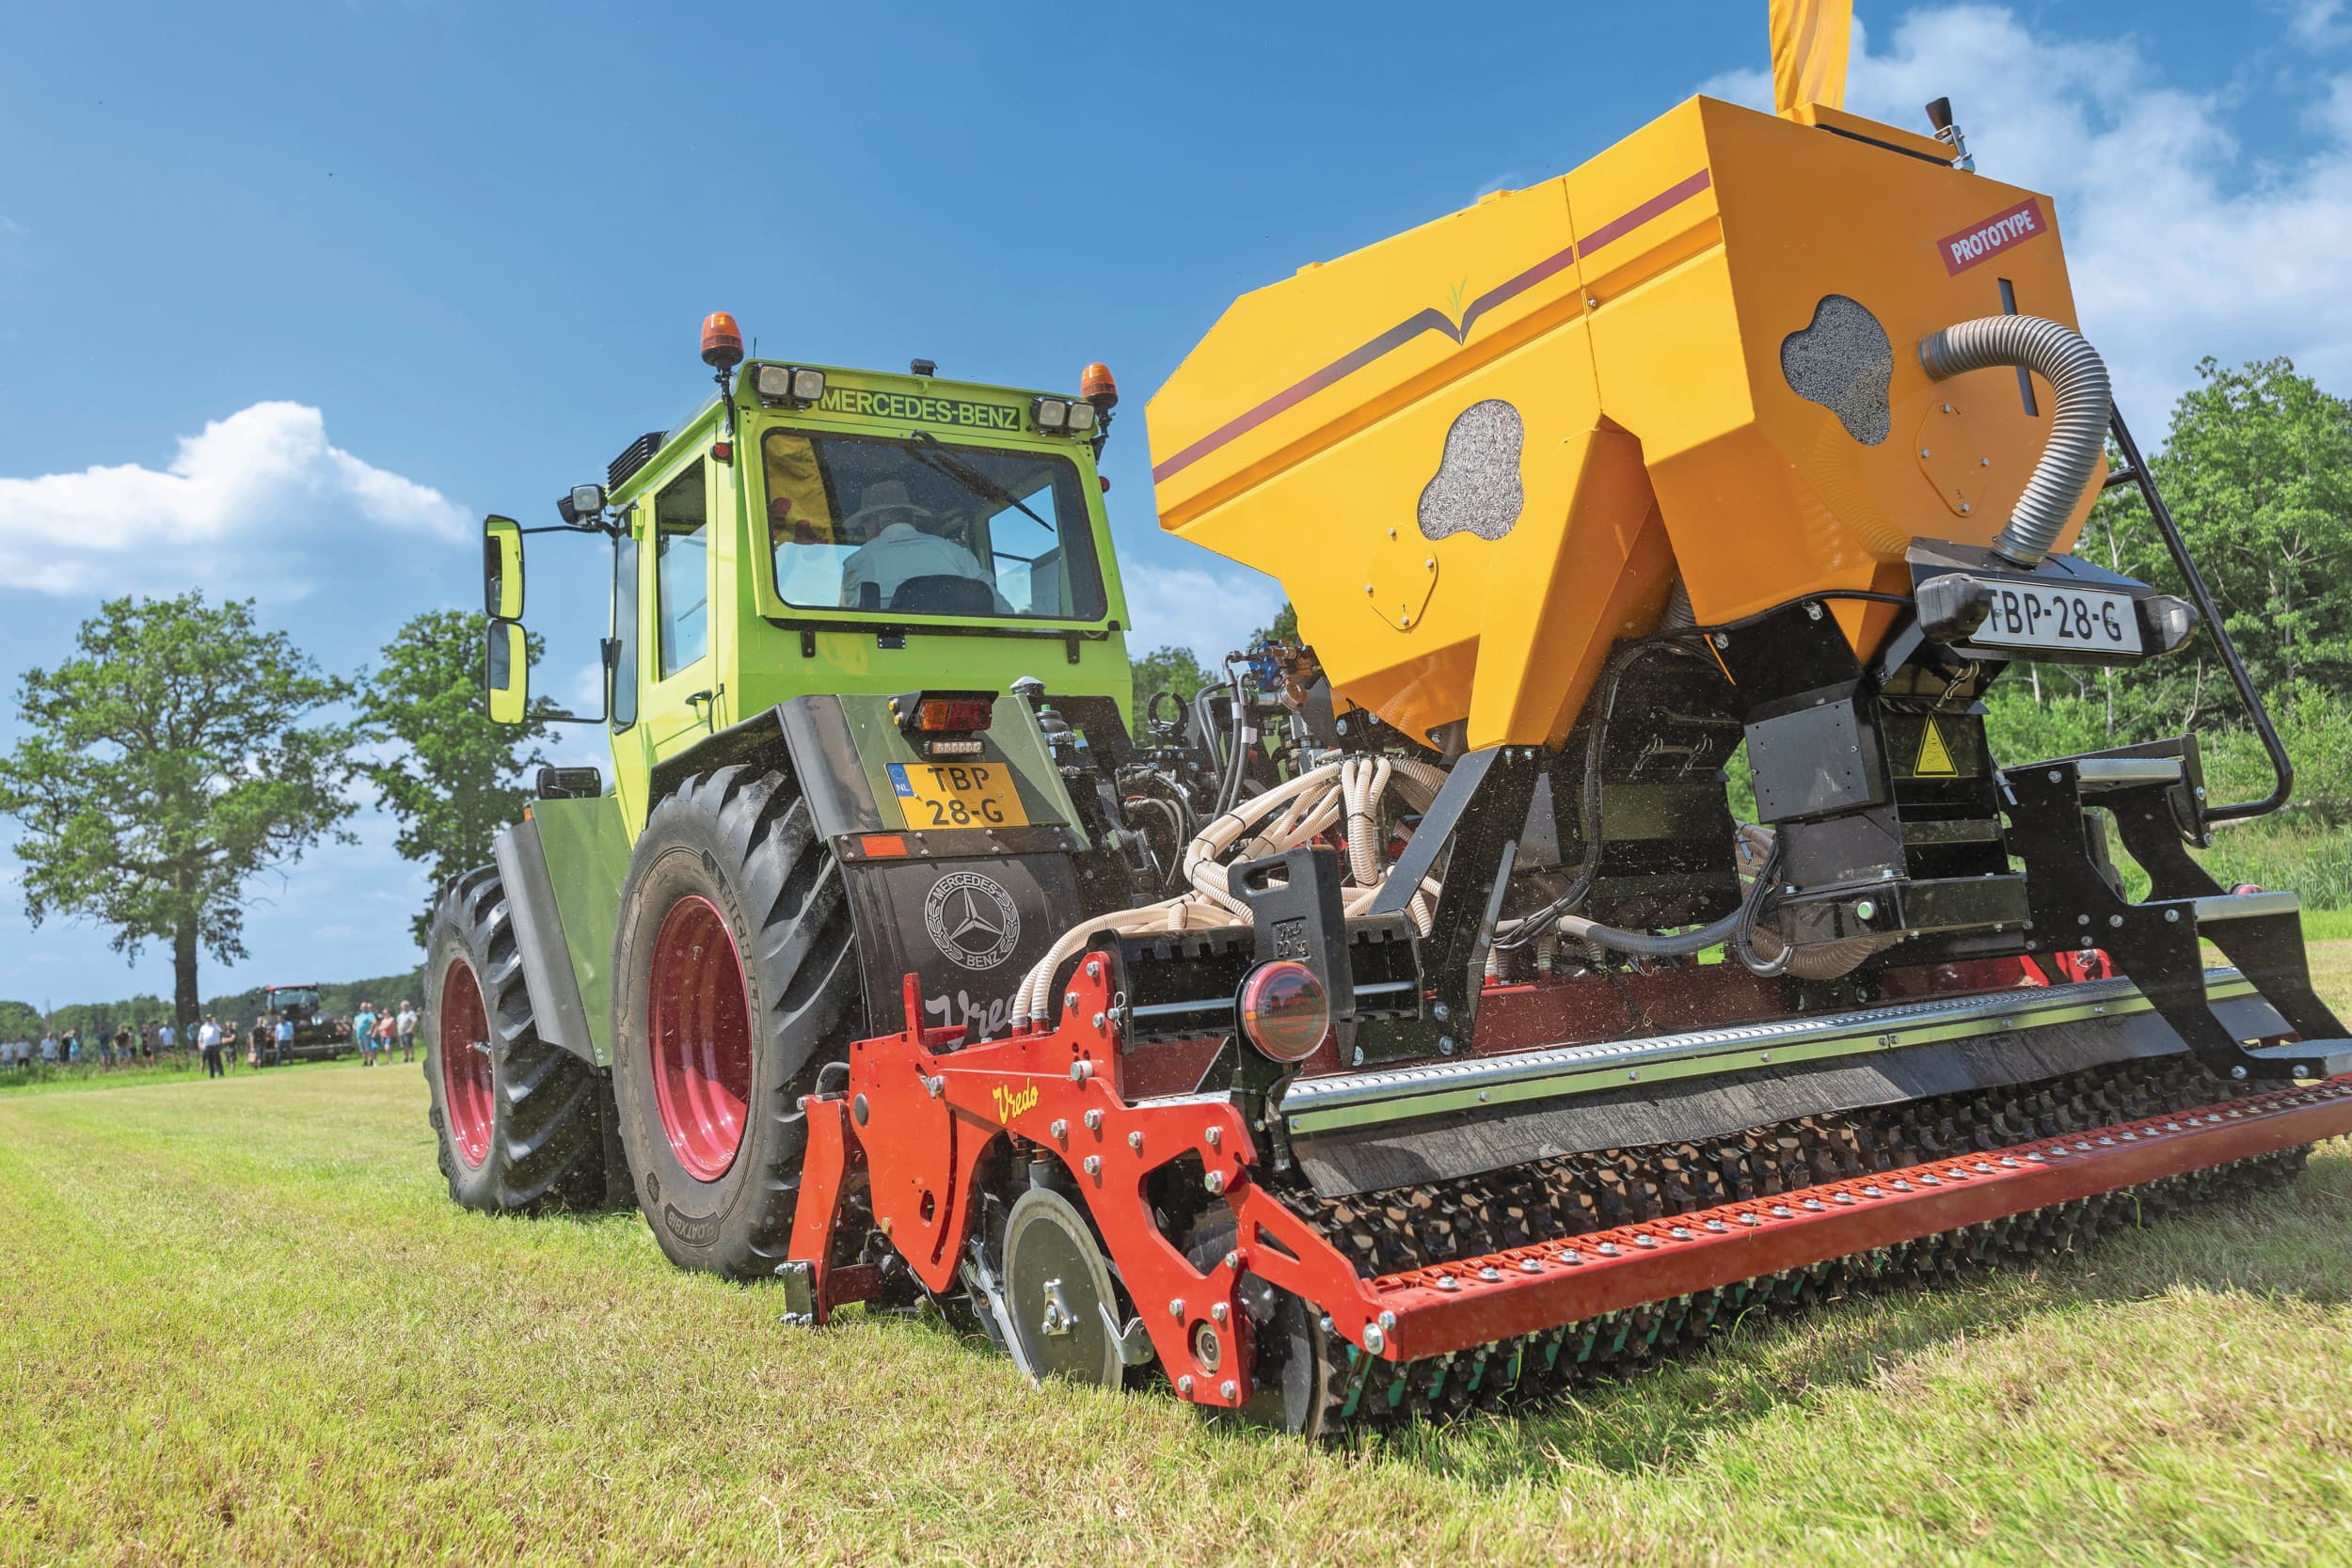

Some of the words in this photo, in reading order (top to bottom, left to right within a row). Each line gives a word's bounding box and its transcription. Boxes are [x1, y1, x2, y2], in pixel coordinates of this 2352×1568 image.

[1950, 209, 2036, 265] PROTOTYPE
[821, 389, 1018, 430] MERCEDES-BENZ
[927, 767, 990, 792] TBP
[925, 799, 1004, 826] 28-G
[932, 874, 998, 900] MERCEDES
[966, 951, 1000, 968] BENZ
[925, 975, 1025, 1051] Vre
[993, 1076, 1039, 1125] Vredo
